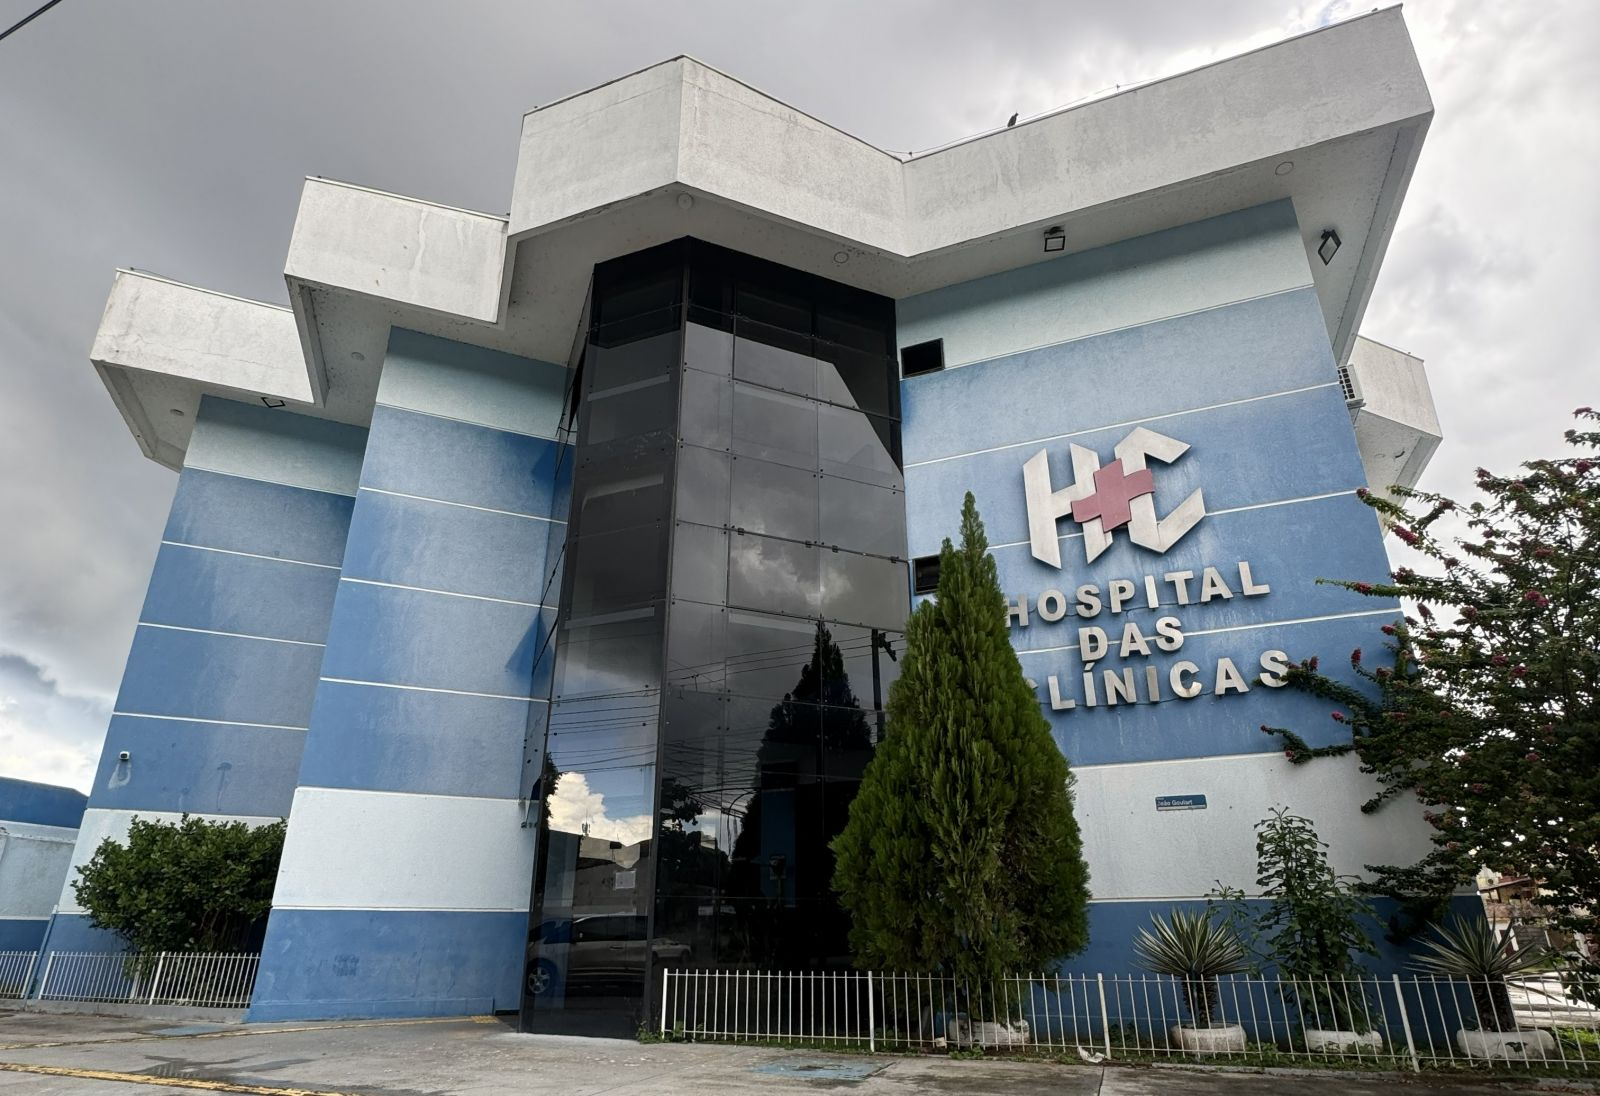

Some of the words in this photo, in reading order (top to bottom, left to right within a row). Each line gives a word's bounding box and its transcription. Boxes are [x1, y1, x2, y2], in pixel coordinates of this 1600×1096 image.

[1005, 561, 1270, 627] HOSPITAL
[1078, 616, 1185, 662] DAS
[1027, 649, 1290, 711] LÍNICAS
